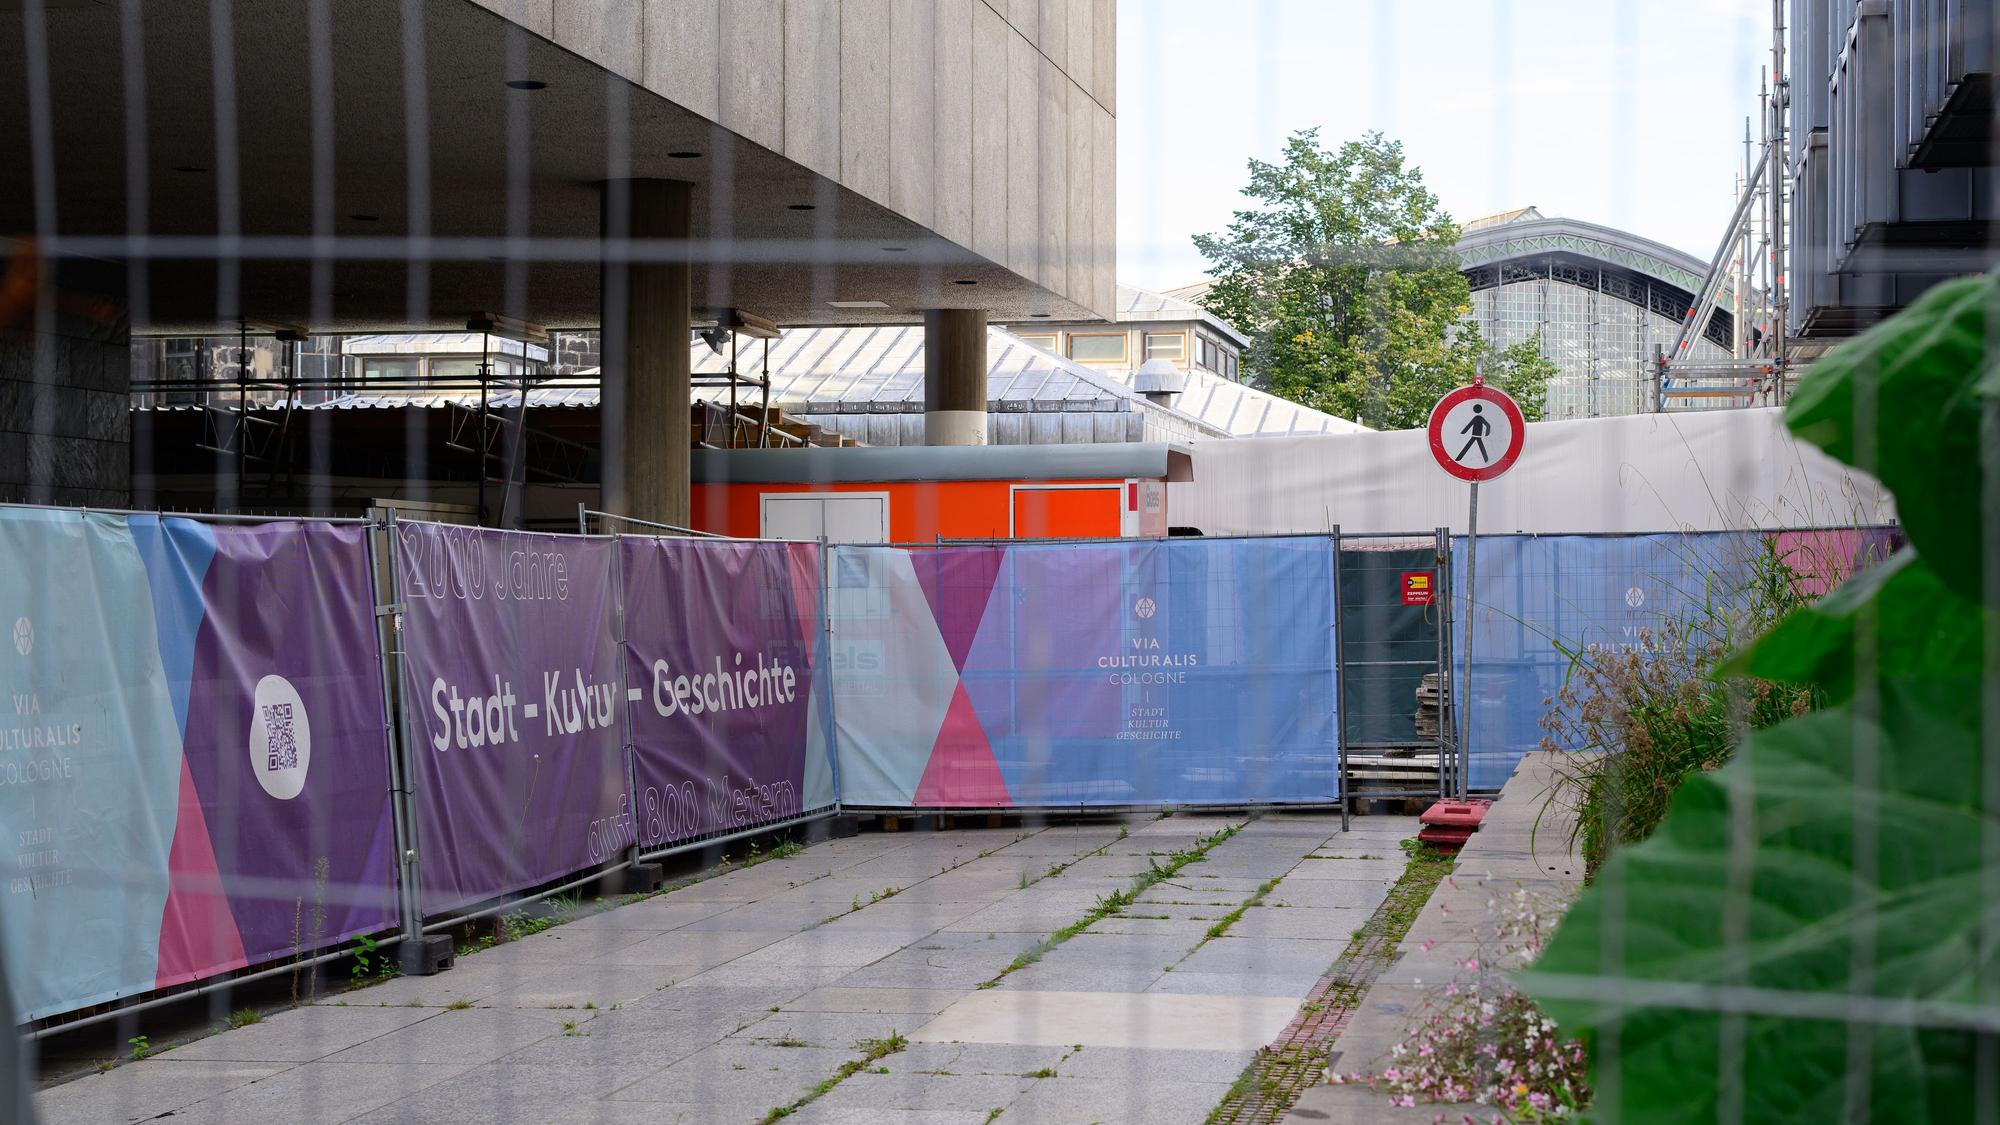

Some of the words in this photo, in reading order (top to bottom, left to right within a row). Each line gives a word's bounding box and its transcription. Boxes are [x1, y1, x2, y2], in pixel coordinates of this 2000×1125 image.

[402, 522, 486, 600] 2000
[495, 531, 569, 601] Jahre
[1132, 638, 1160, 649] VIA
[1098, 654, 1197, 668] CULTURALIS
[1109, 672, 1187, 685] COLOGNE
[13, 694, 41, 716] VIA
[432, 674, 519, 751] Stadt
[544, 668, 617, 736] Kultur
[653, 652, 796, 717] Geschichte
[1131, 707, 1165, 717] STADT
[1128, 719, 1169, 729] KULTUR
[1116, 731, 1182, 740] GESCHICHTE
[587, 793, 631, 866] auf
[645, 780, 700, 846] 800
[706, 775, 797, 834] Metern
[19, 828, 54, 847] STADT
[17, 849, 60, 869] KULTUR
[10, 869, 73, 895] GESCHICHTE
